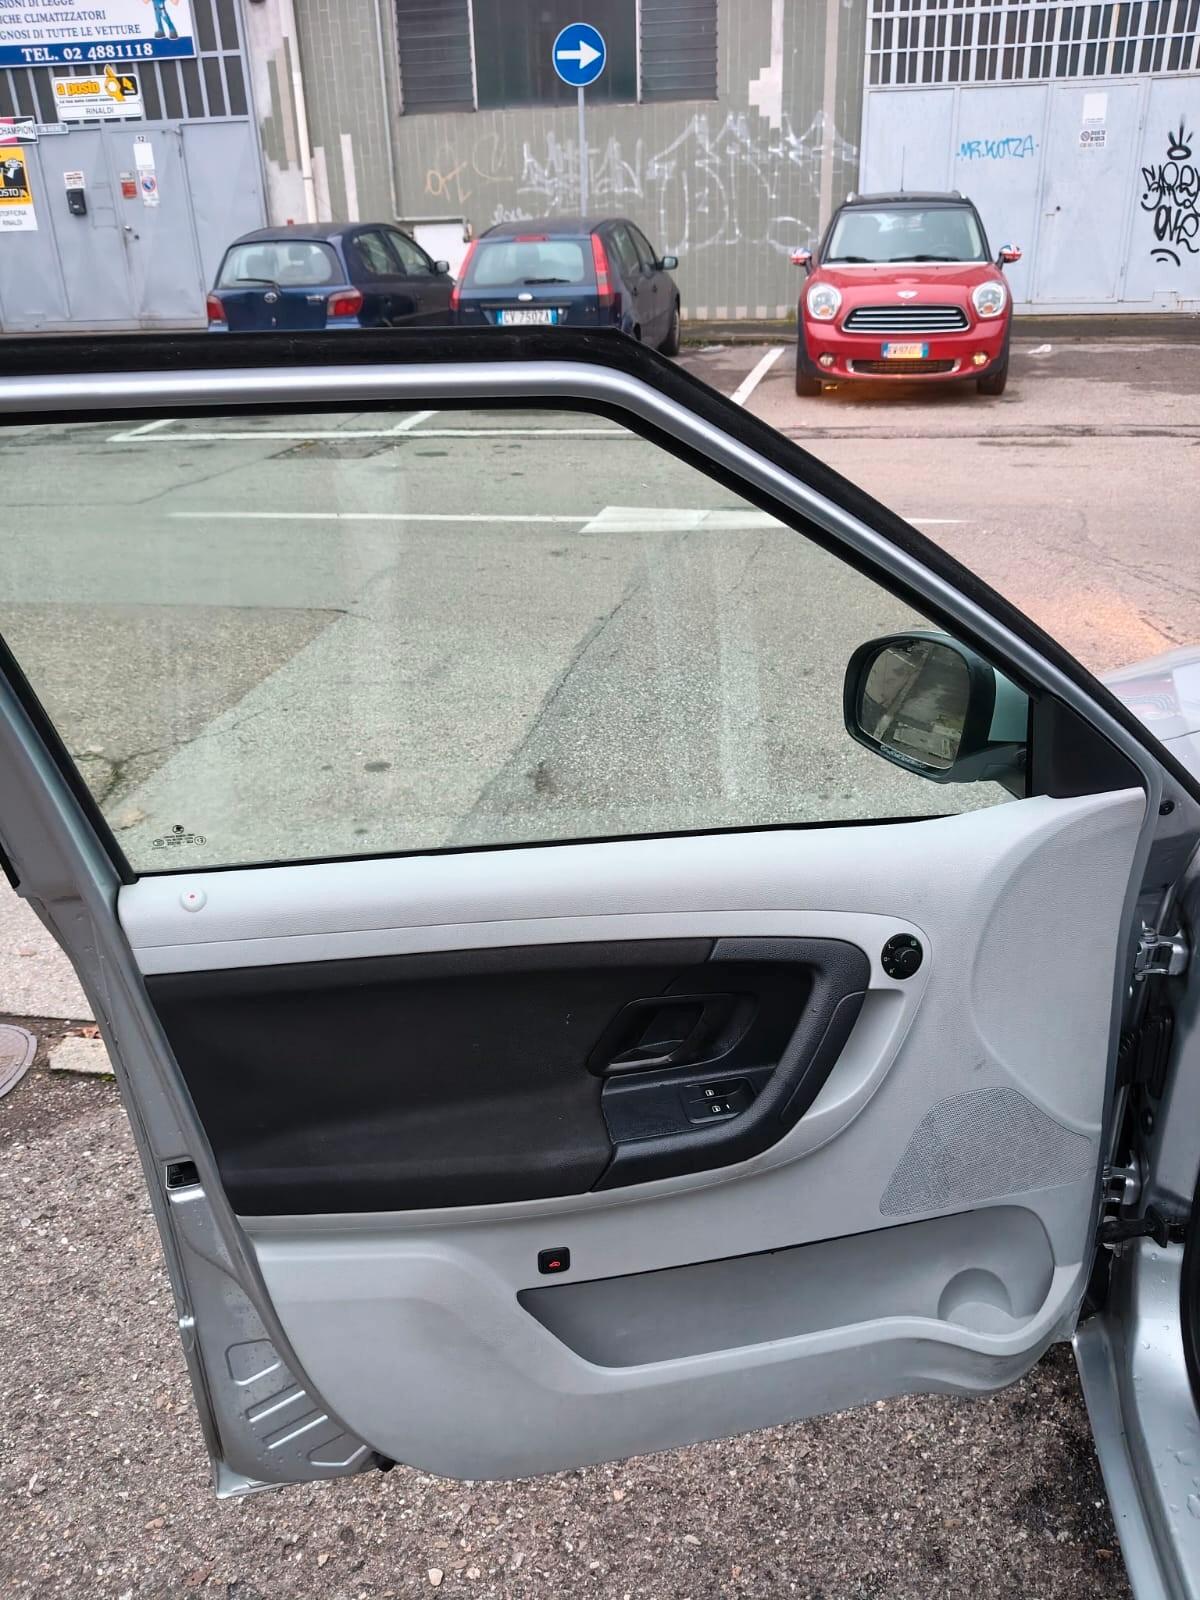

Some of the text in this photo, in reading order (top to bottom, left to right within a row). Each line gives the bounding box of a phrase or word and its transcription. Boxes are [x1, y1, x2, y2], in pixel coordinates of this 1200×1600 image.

[24, 10, 106, 23] CLIMATIZZATORI
[32, 29, 44, 38] DI
[46, 27, 79, 38] TUTTE
[81, 26, 94, 36] LE
[96, 24, 142, 36] VETTURE
[21, 43, 153, 62] TEL. 02 4881118
[86, 106, 114, 114] RINALDI
